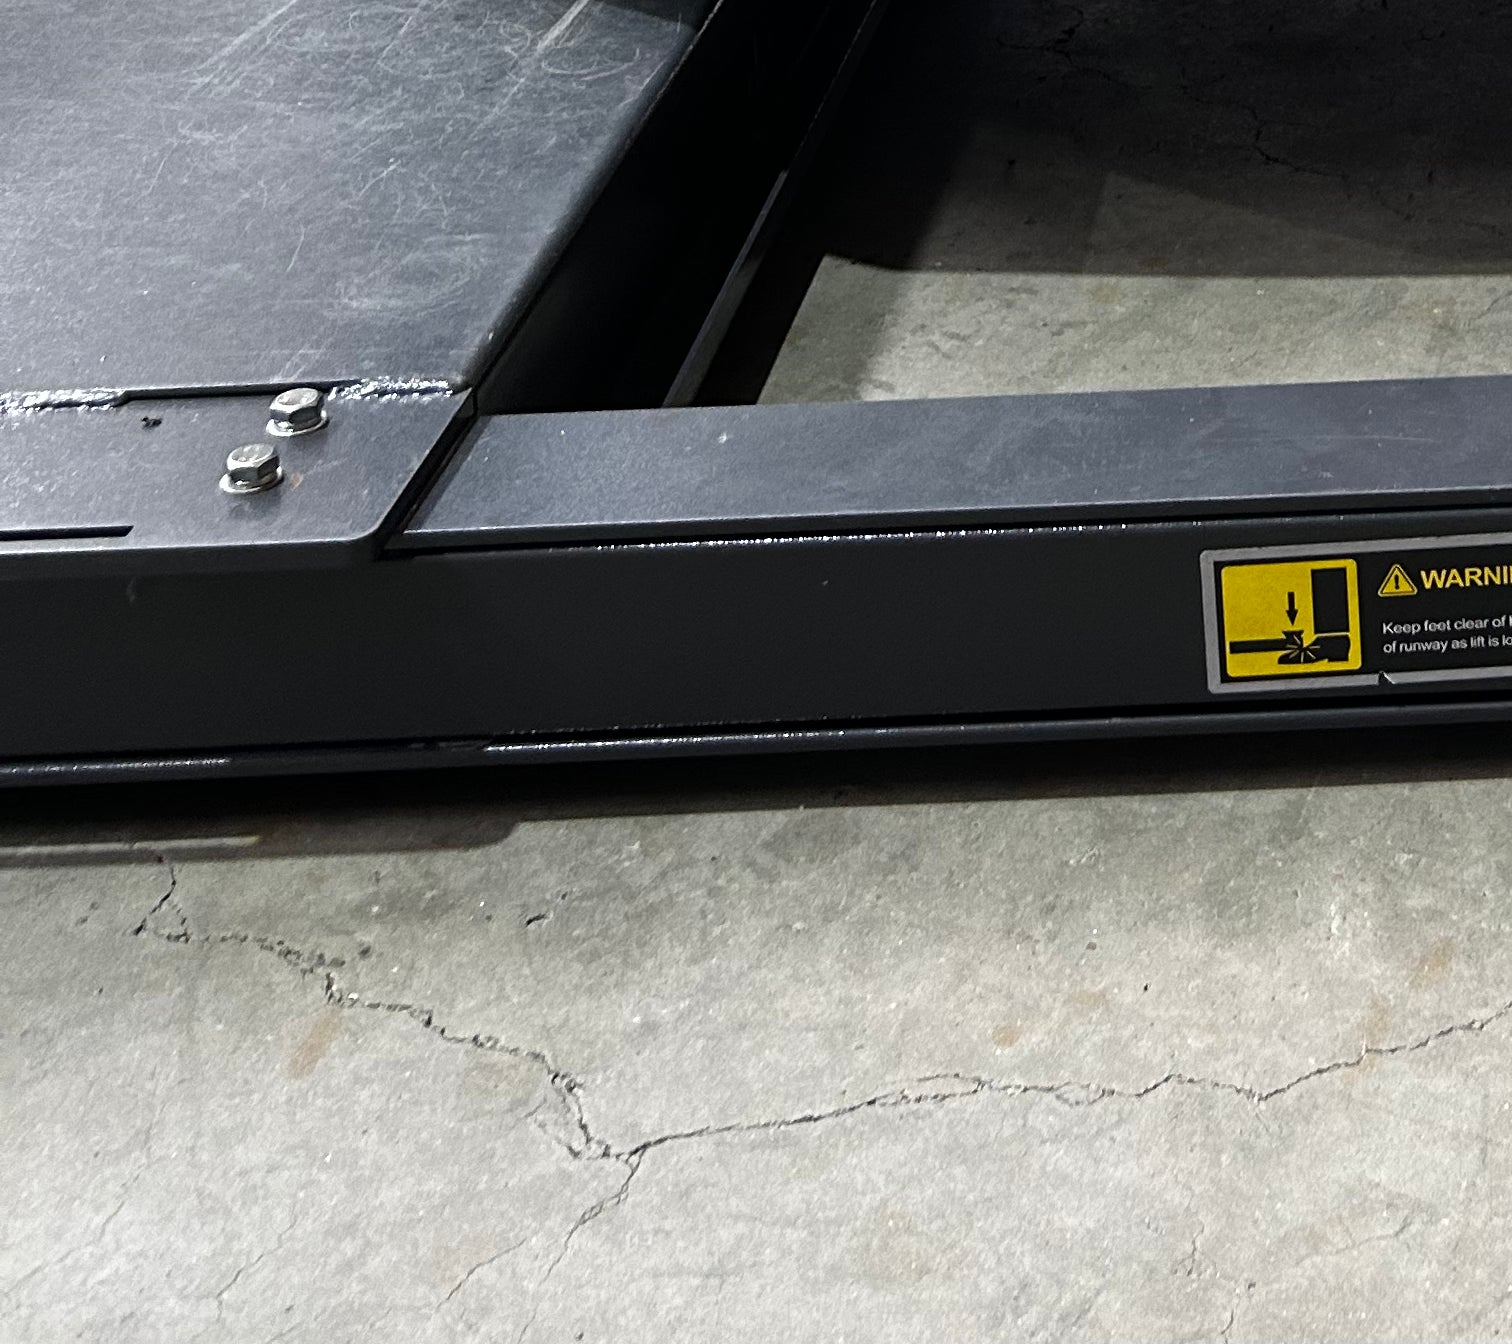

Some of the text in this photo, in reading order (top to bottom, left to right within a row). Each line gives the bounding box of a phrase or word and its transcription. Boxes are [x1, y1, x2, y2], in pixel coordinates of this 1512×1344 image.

[1382, 621, 1422, 636] Keep
[1454, 617, 1489, 631] clear
[1491, 614, 1507, 628] of
[1383, 640, 1398, 654] of
[1399, 639, 1449, 654] runway
[1451, 638, 1468, 650] as
[1470, 635, 1486, 649] lift
[1488, 634, 1500, 647] is
